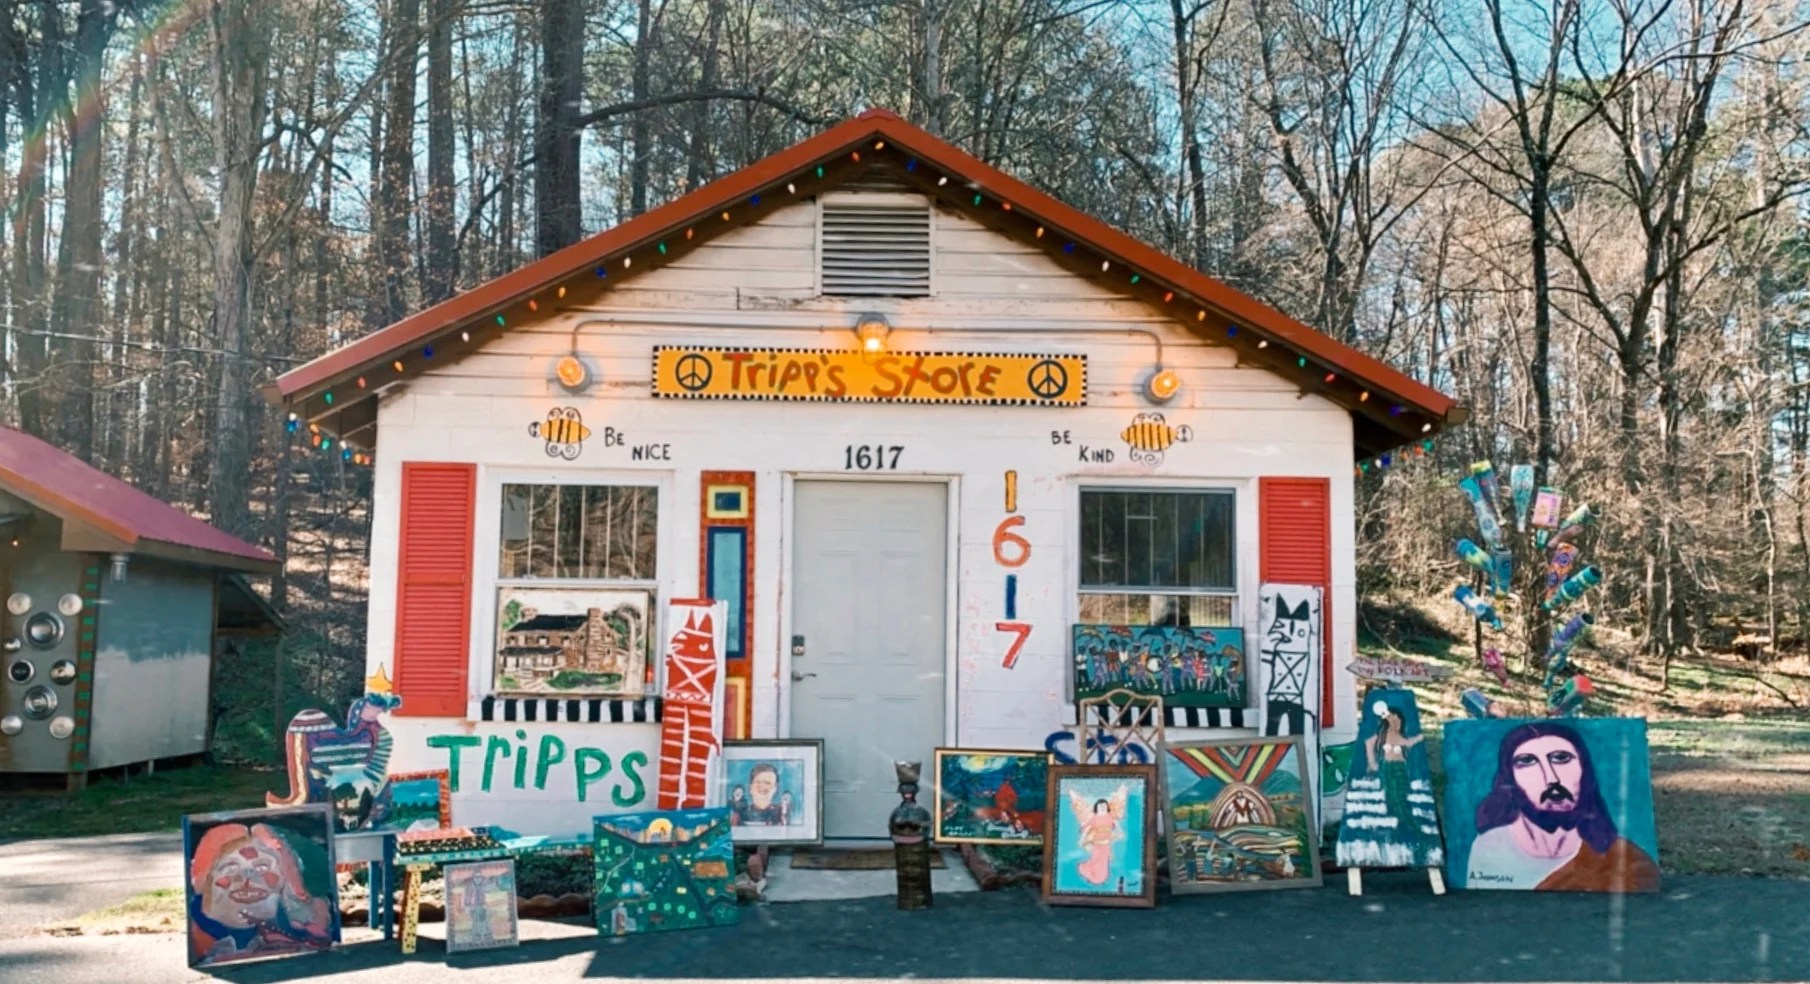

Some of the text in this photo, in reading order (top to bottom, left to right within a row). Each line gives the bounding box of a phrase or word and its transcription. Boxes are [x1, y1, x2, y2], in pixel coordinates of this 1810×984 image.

[1051, 430, 1072, 445] BE
[632, 443, 671, 460] NICE
[845, 444, 905, 470] 1617
[1078, 444, 1115, 462] KIND
